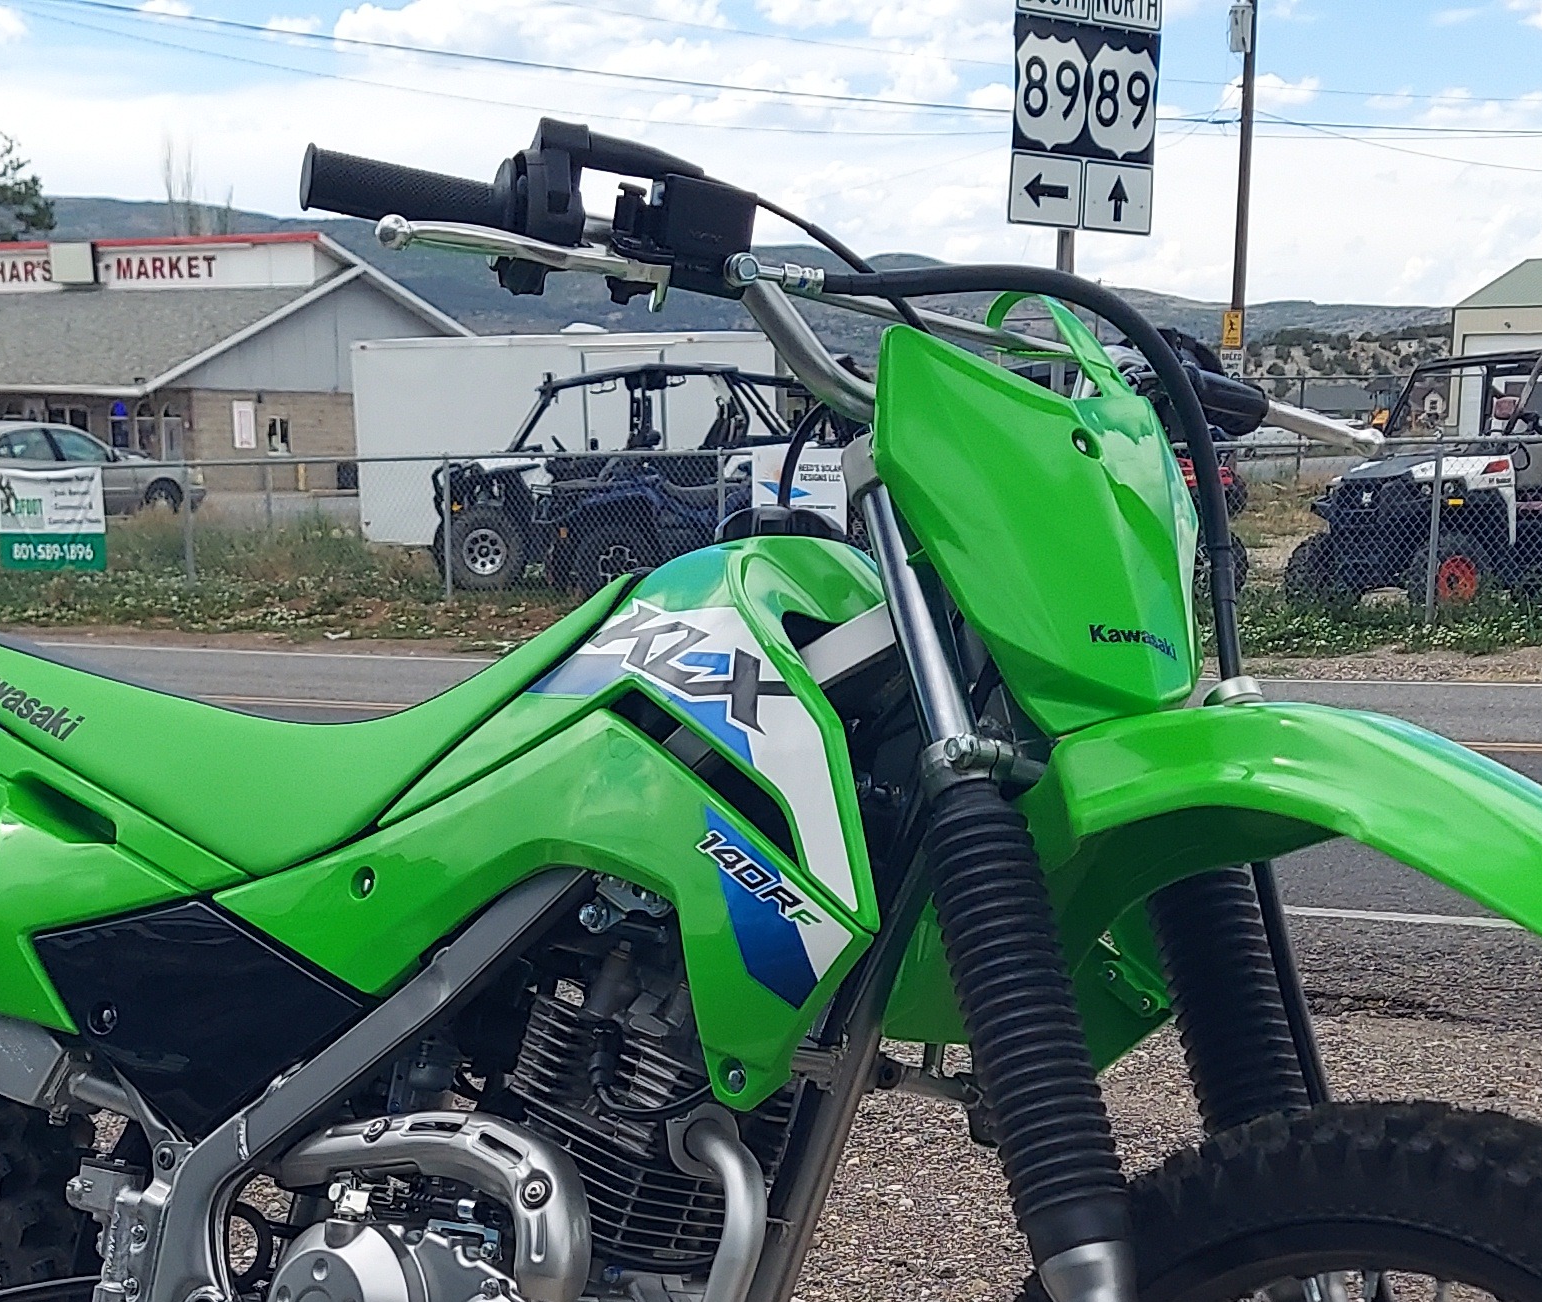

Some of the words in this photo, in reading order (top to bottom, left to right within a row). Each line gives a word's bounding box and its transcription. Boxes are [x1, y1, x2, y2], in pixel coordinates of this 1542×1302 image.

[1023, 55, 1081, 121] 89
[1095, 68, 1151, 129] 89
[116, 254, 217, 281] MARKET
[828, 474, 841, 482] LLC
[1088, 624, 1178, 661] Kawasaki
[588, 603, 797, 736] KLX
